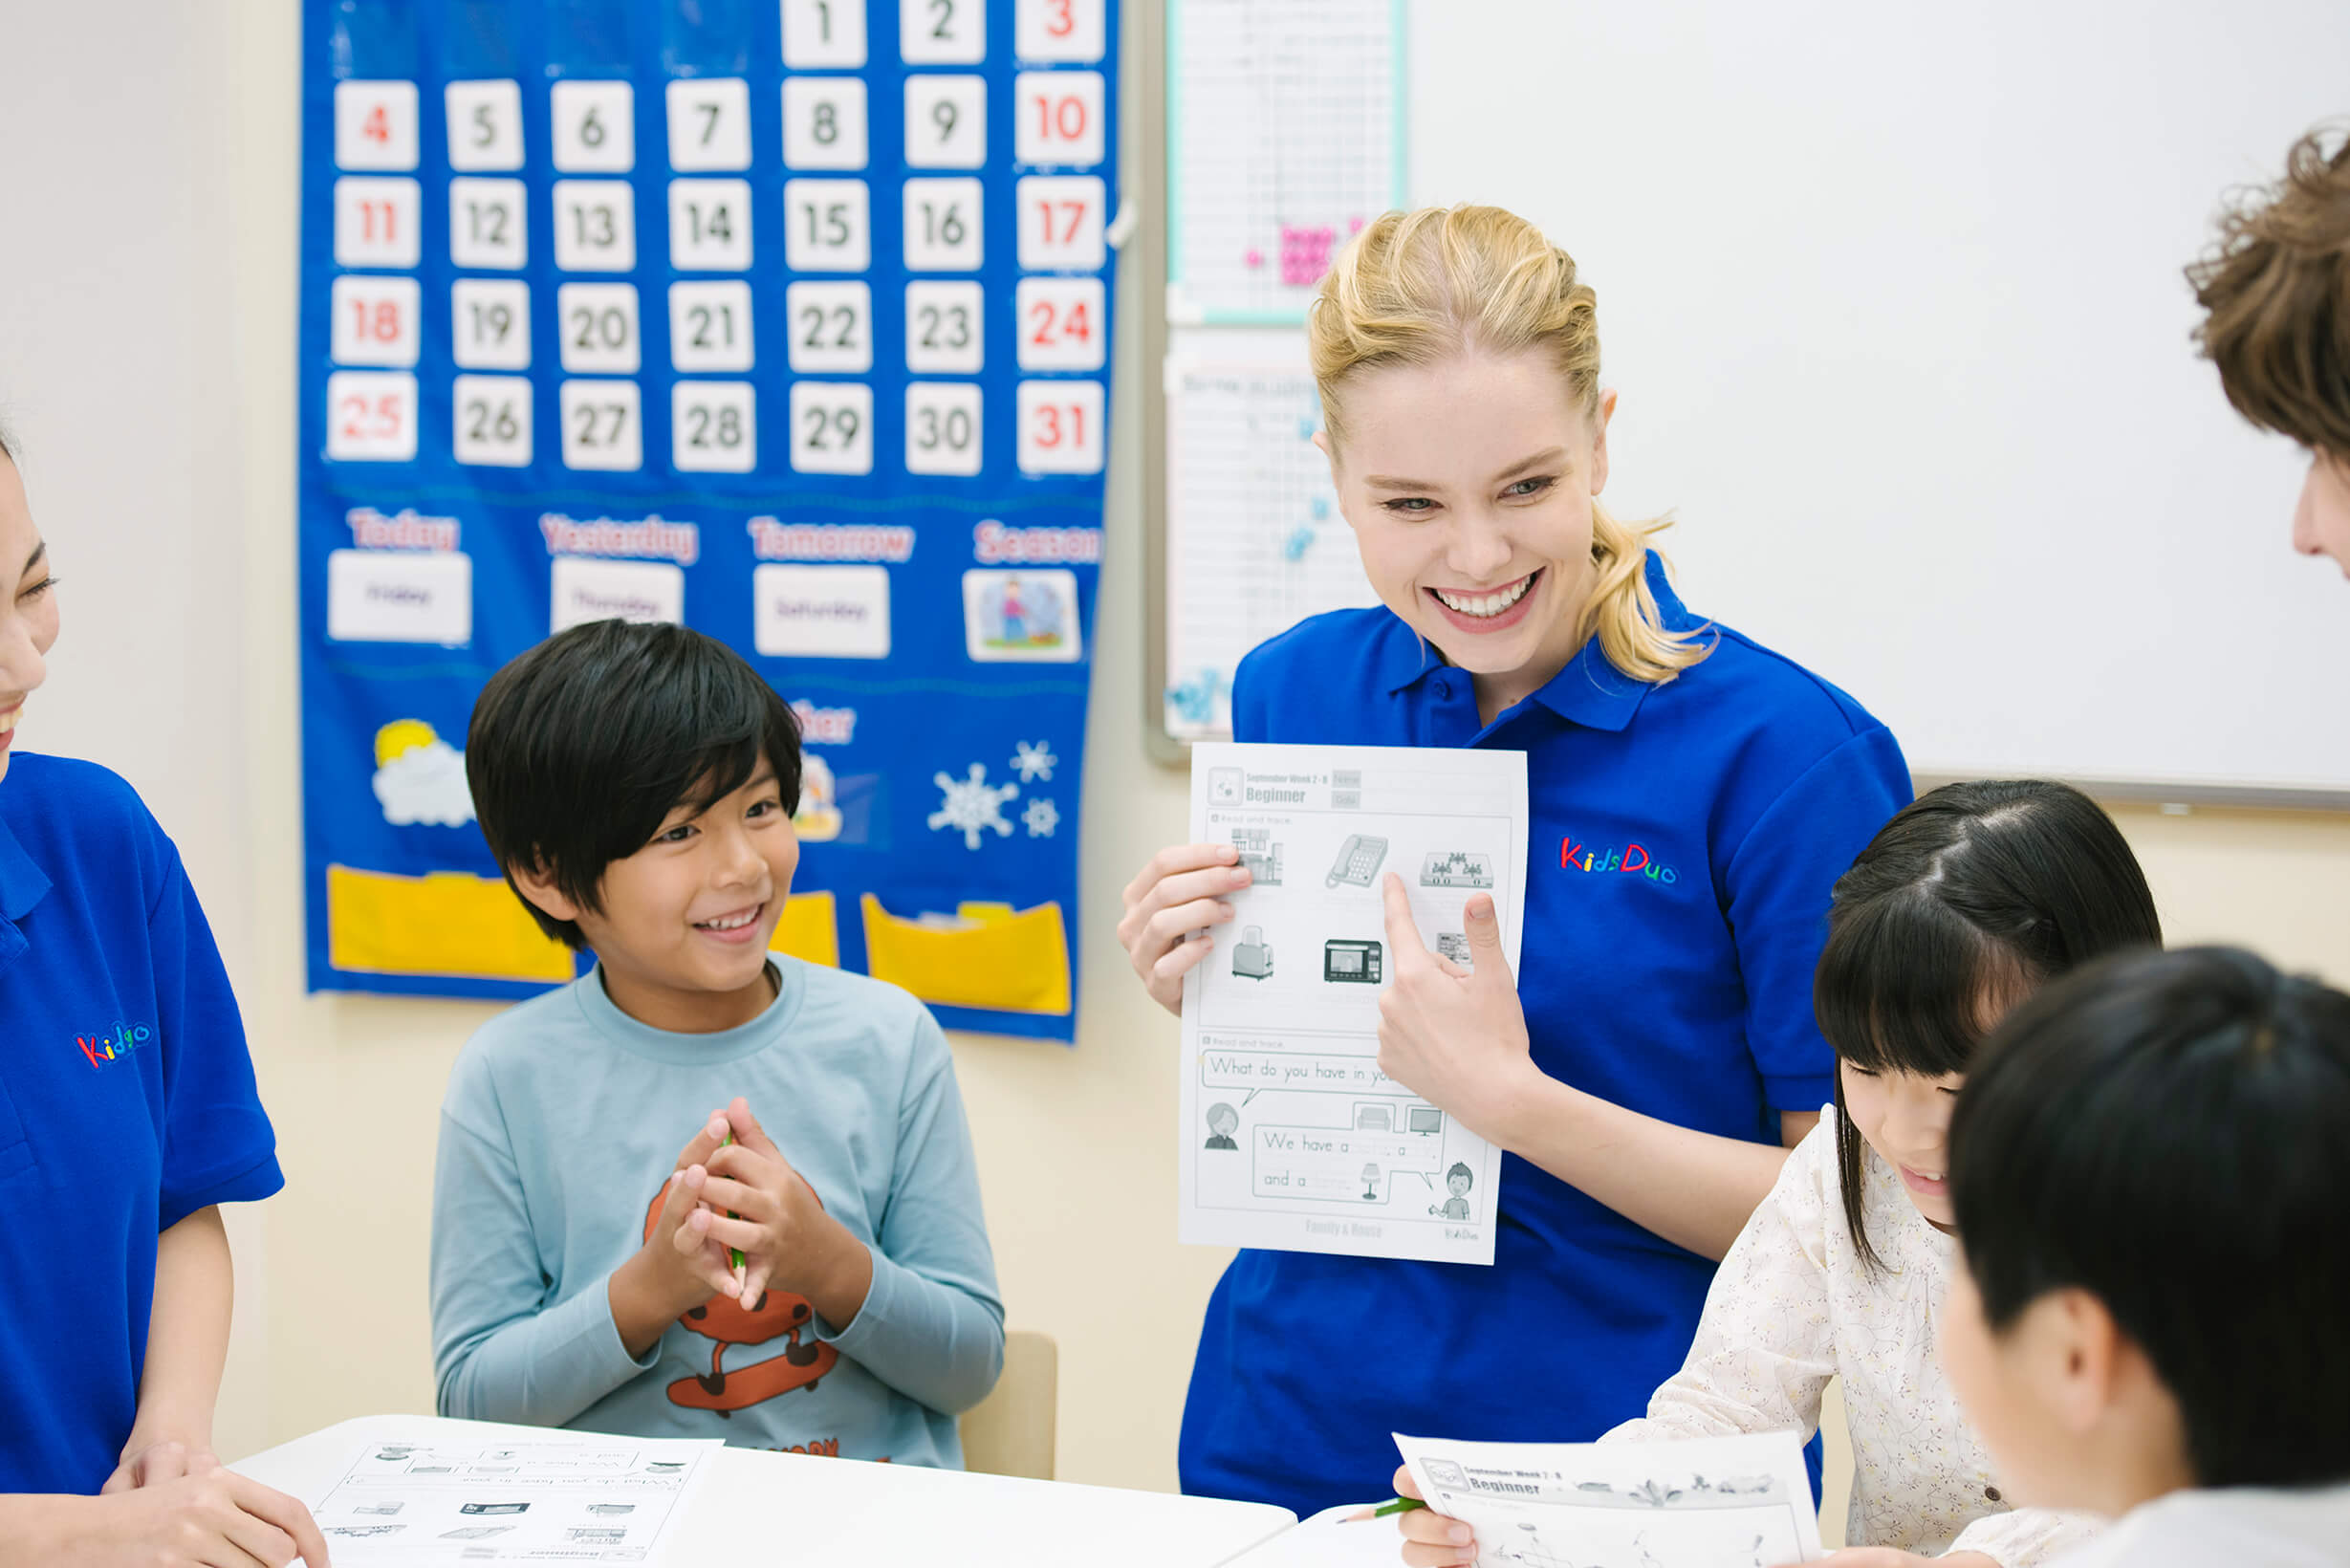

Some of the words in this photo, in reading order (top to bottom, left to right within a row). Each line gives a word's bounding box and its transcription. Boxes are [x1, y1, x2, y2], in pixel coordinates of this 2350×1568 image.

[817, 0, 830, 43] 1
[929, 0, 953, 40] 2
[1046, 0, 1074, 38] 3
[361, 102, 391, 149] 4
[472, 104, 496, 149] 5
[578, 107, 606, 149] 6
[694, 103, 722, 146] 7
[812, 101, 838, 146] 8
[932, 99, 959, 144] 9
[1034, 95, 1087, 142] 10
[357, 200, 396, 243] 11
[468, 202, 510, 245] 12
[571, 204, 618, 248] 13
[685, 203, 732, 245] 14
[802, 203, 849, 247] 15
[920, 203, 965, 247] 16
[1037, 201, 1087, 245] 17
[350, 298, 402, 343] 18
[470, 302, 512, 344] 19
[574, 306, 628, 350] 20
[688, 304, 734, 348] 21
[802, 305, 858, 349] 22
[919, 306, 971, 350] 23
[1030, 301, 1090, 345] 24
[340, 394, 402, 438] 25
[467, 398, 518, 443] 26
[575, 404, 627, 446] 27
[686, 404, 742, 448] 28
[804, 406, 860, 449] 29
[918, 406, 972, 451] 30
[1034, 404, 1087, 448] 31
[347, 508, 460, 551] Today
[540, 512, 699, 565] Yesterday
[748, 517, 914, 562] Tomorrow
[1246, 787, 1306, 803] Beginner
[1210, 1057, 1252, 1075] What
[1262, 1058, 1276, 1076] do
[1285, 1066, 1308, 1083] you
[1316, 1062, 1345, 1078] have
[1354, 1065, 1365, 1079] in
[1370, 1070, 1393, 1086] yo
[1264, 1132, 1294, 1150] We
[1303, 1134, 1332, 1152] have
[1340, 1143, 1349, 1153] a
[1264, 1170, 1290, 1187] and
[1297, 1177, 1306, 1187] a
[1469, 1477, 1540, 1494] Beginner
